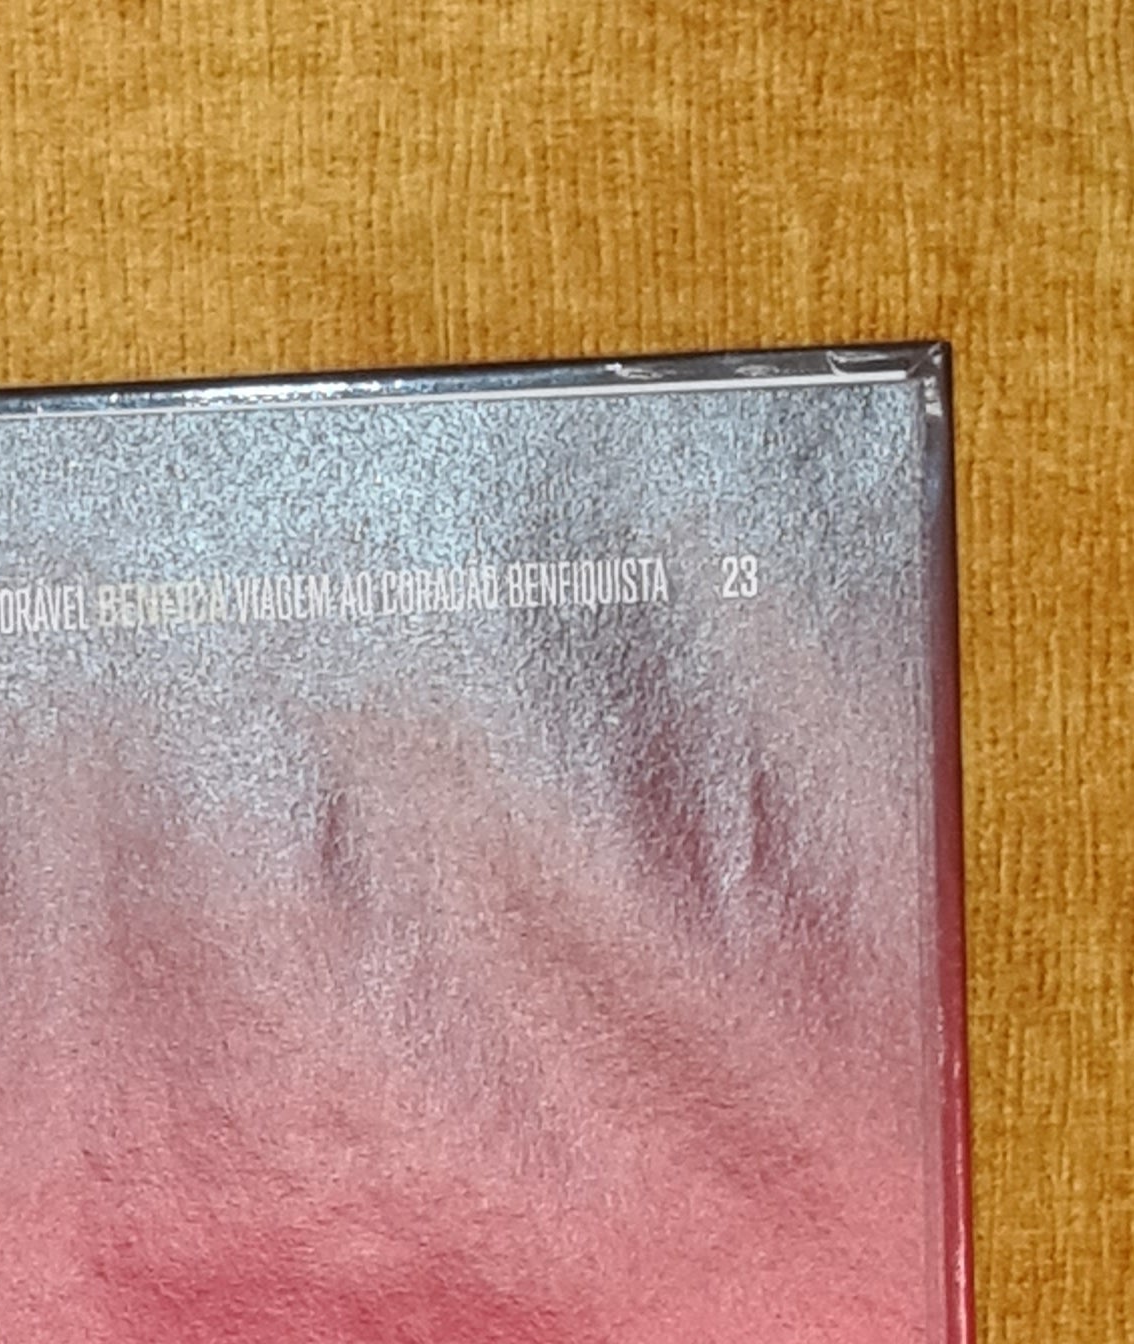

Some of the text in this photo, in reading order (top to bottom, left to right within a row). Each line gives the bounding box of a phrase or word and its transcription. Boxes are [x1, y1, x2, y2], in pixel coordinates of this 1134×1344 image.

[235, 574, 329, 624] VIAGEM
[340, 579, 368, 618] AO
[382, 564, 499, 616] CORAÇÃO
[509, 557, 666, 616] BENFIQUISTA
[722, 554, 758, 598] 23
